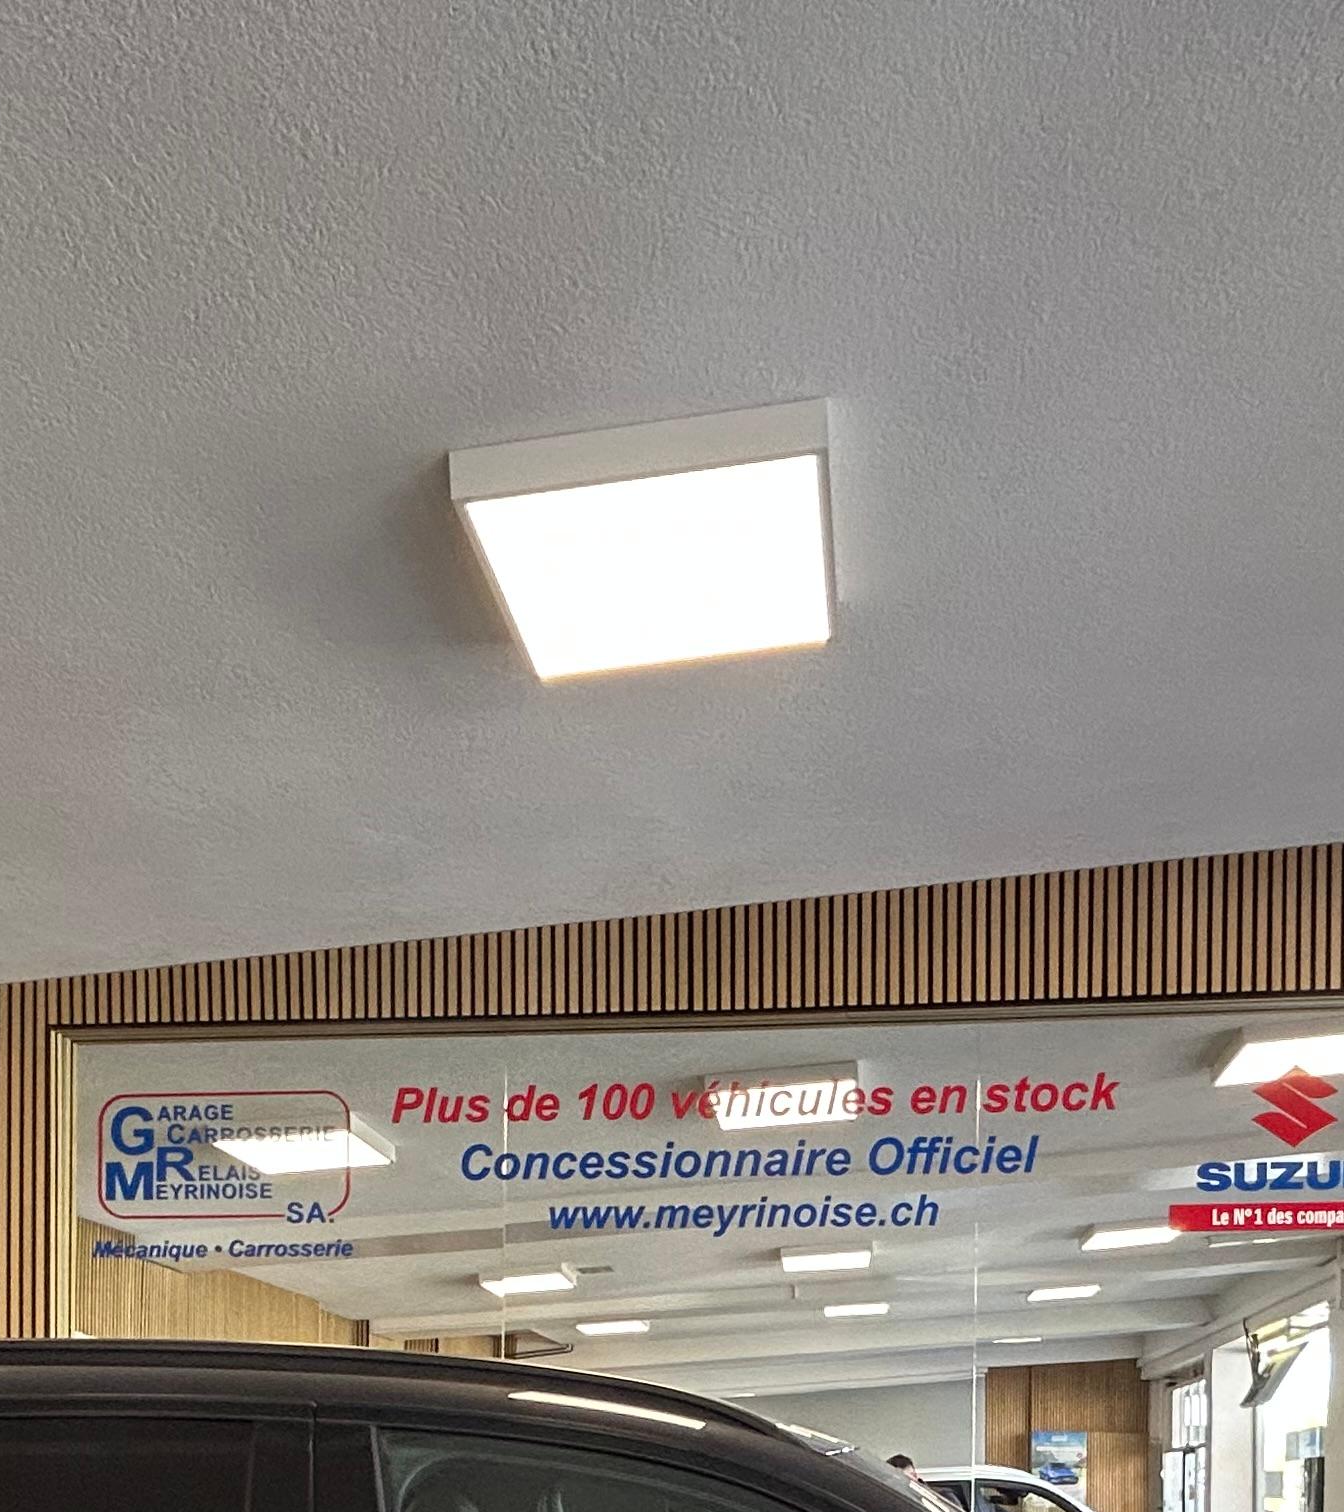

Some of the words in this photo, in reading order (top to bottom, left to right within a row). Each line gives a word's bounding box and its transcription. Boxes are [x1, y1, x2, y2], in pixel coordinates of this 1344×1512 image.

[392, 1086, 490, 1123] Plus
[506, 1085, 560, 1121] de
[577, 1083, 655, 1120] 100
[671, 1079, 894, 1119] véhicules
[910, 1084, 967, 1115] en
[982, 1072, 1120, 1113] stock
[110, 1104, 234, 1156] GARAGE
[156, 1146, 261, 1182] RELAIS
[460, 1140, 851, 1181] Concessionnaire
[868, 1135, 1040, 1175] Officiel
[106, 1161, 273, 1201] MEYRINOISE
[549, 1194, 940, 1237] www.meyrinoise.ch
[1212, 1208, 1229, 1226] Le
[1267, 1207, 1293, 1225] des
[92, 1240, 208, 1262] Mécanique
[228, 1238, 353, 1258] Carrosserie
